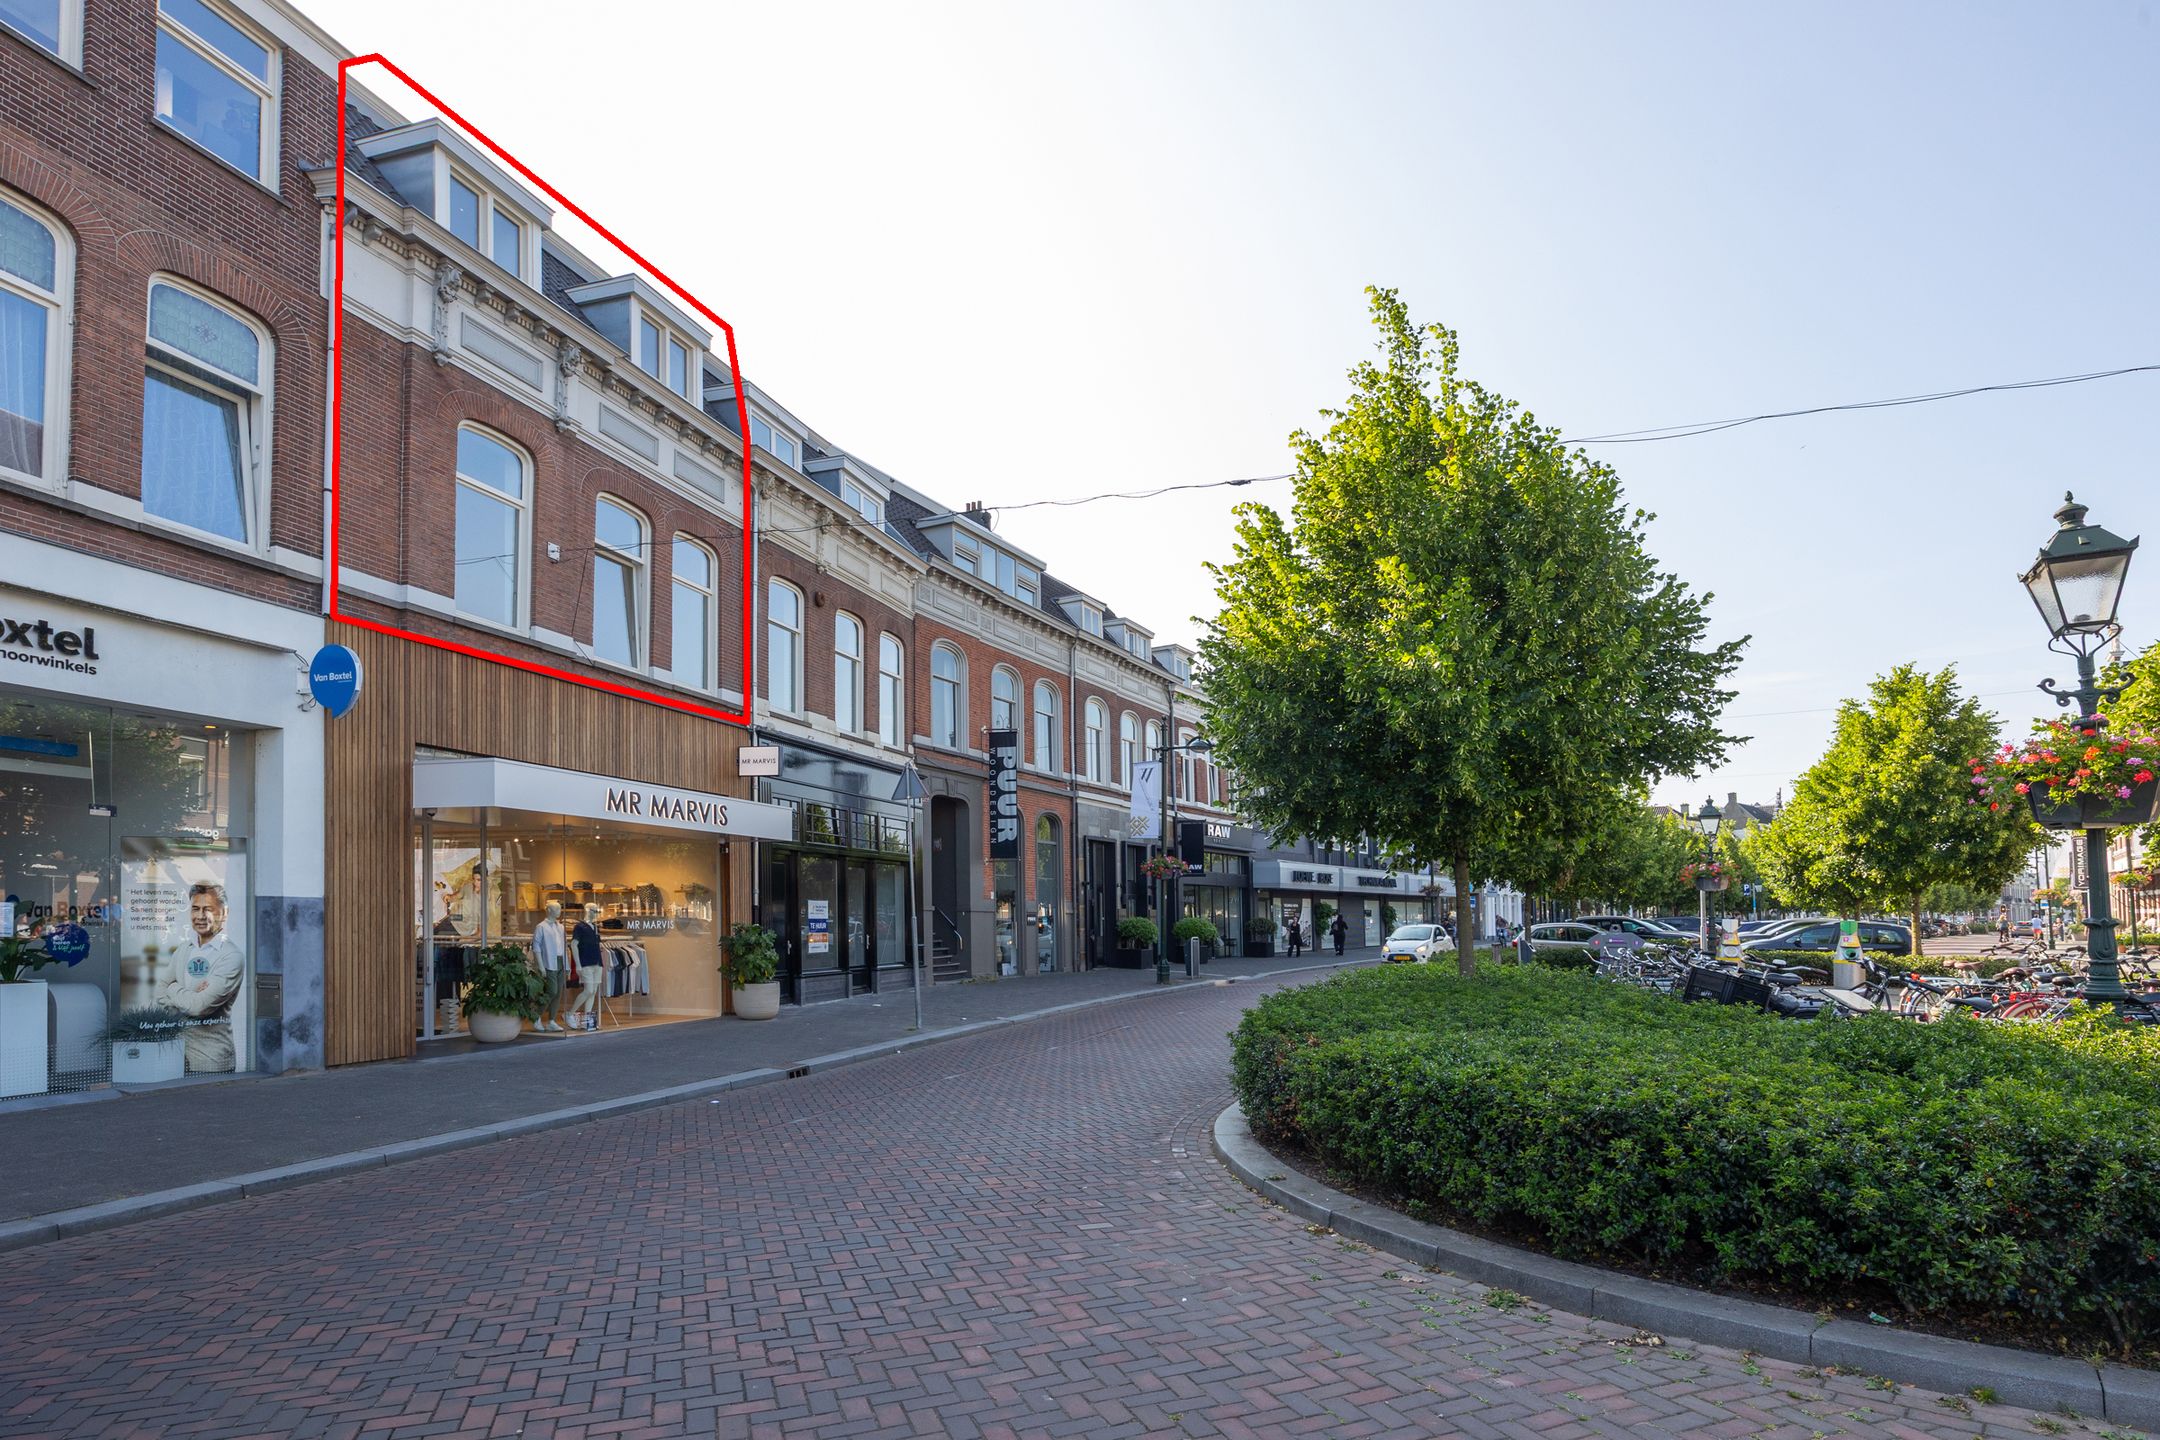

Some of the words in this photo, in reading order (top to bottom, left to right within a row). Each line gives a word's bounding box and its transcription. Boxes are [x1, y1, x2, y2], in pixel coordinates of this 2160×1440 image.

[0, 618, 99, 660] xtel
[314, 674, 328, 682] Van
[329, 671, 352, 681] Boxtel
[605, 787, 641, 816] MR
[649, 794, 728, 827] MARVIS
[989, 747, 997, 844] WOONDESIGN
[997, 746, 1017, 843] PUUR
[1207, 823, 1231, 839] RAW
[627, 920, 640, 929] MR
[642, 920, 675, 929] MARVIS
